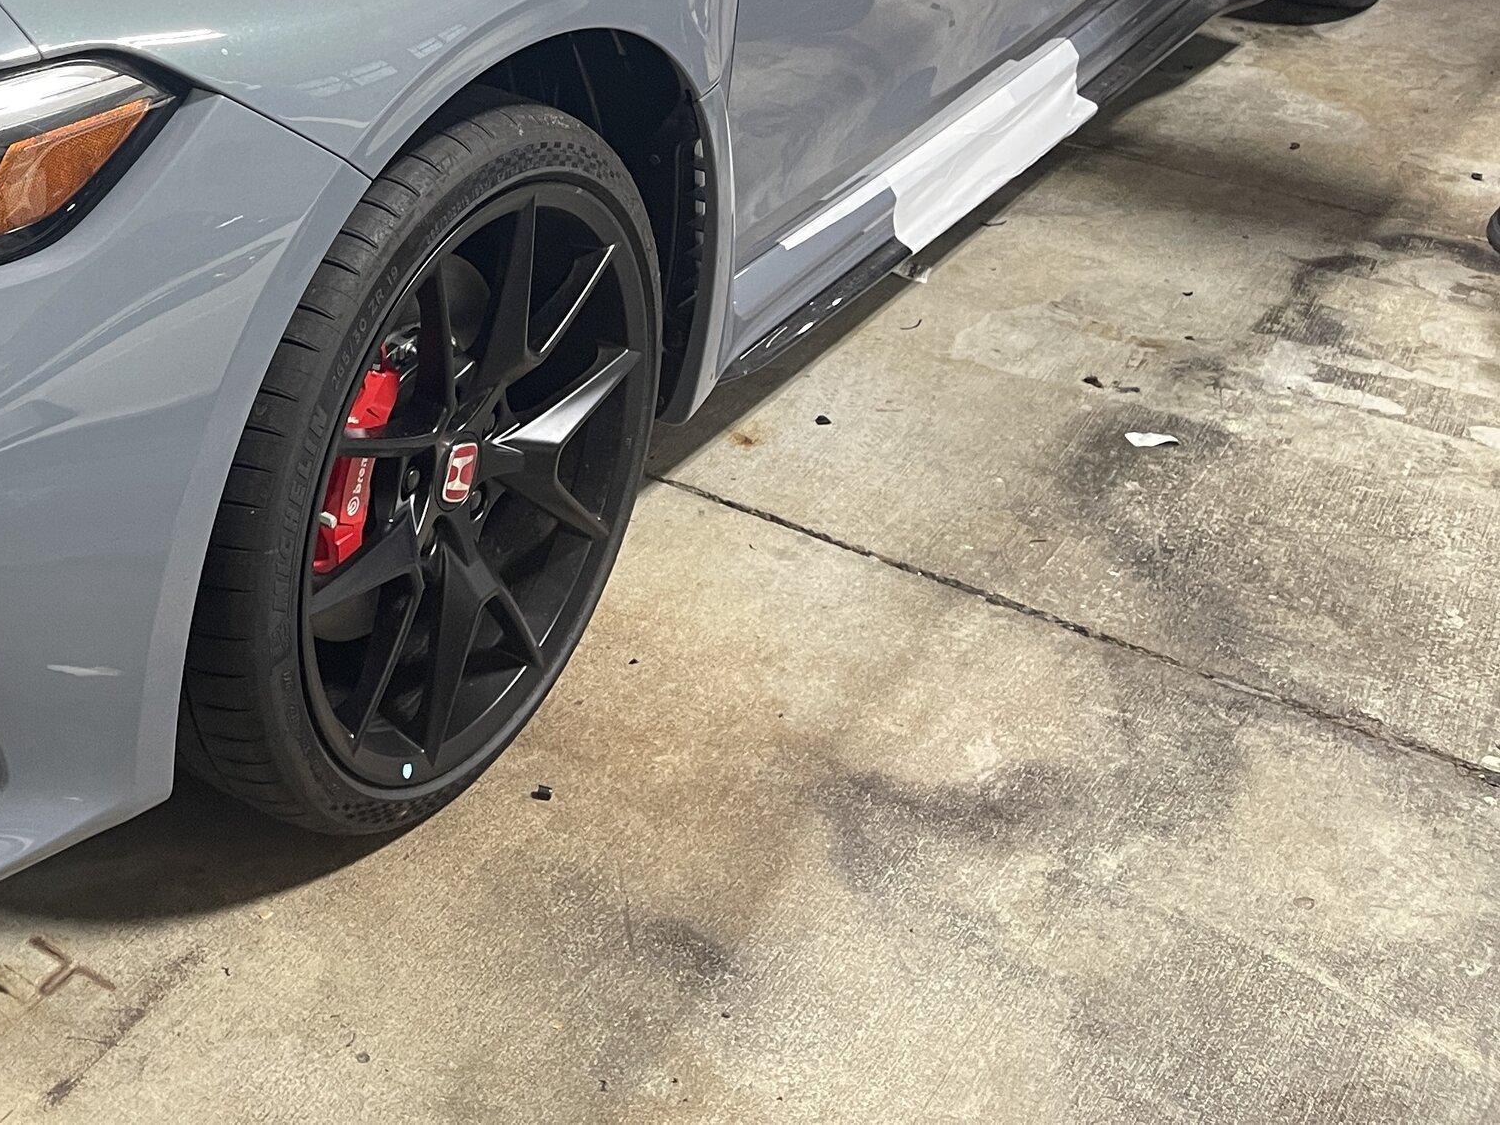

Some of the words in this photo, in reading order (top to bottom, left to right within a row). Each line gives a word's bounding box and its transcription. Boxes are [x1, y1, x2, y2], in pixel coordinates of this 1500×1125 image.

[366, 287, 386, 317] ZR
[385, 263, 398, 287] 19
[353, 457, 368, 494] brem
[271, 404, 328, 614] MICHELIN
